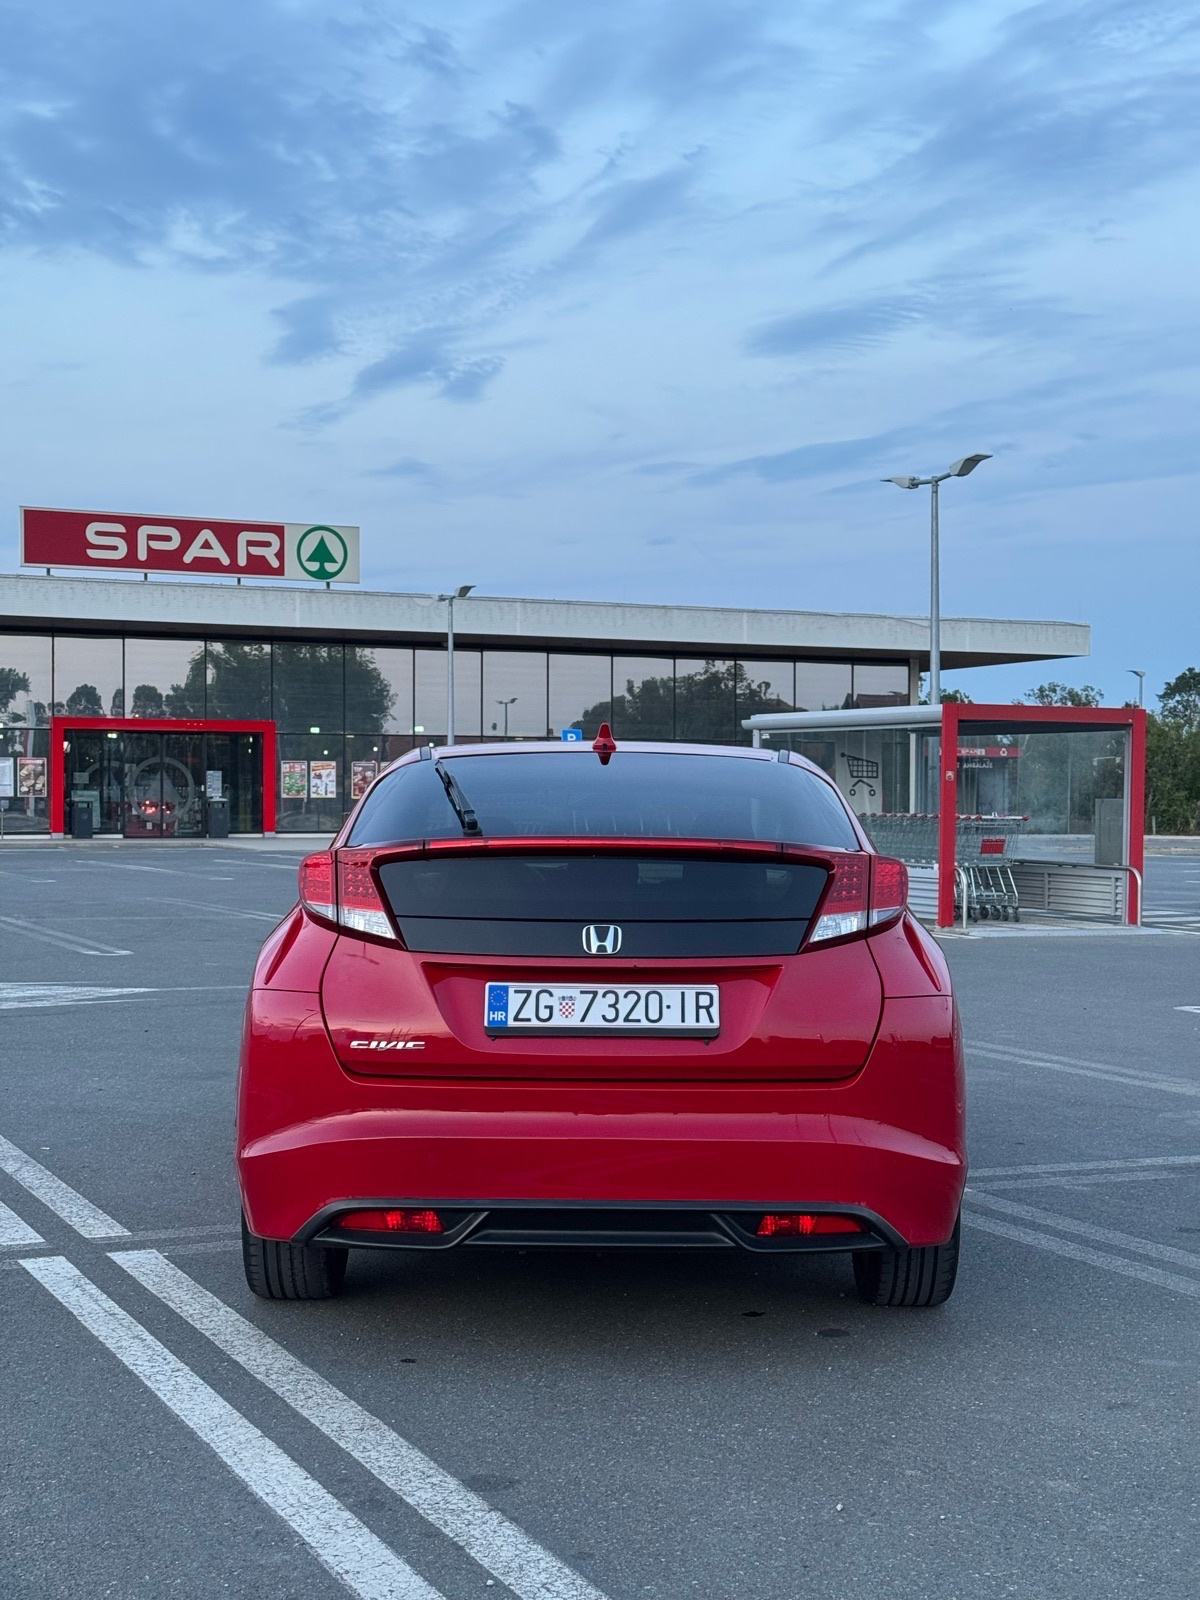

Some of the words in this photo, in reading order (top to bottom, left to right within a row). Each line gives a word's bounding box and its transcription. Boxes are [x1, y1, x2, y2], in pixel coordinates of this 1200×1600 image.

[85, 522, 281, 568] SPAR
[490, 1011, 506, 1021] HR
[513, 989, 554, 1023] ZG
[349, 1040, 426, 1051] CIVIC
